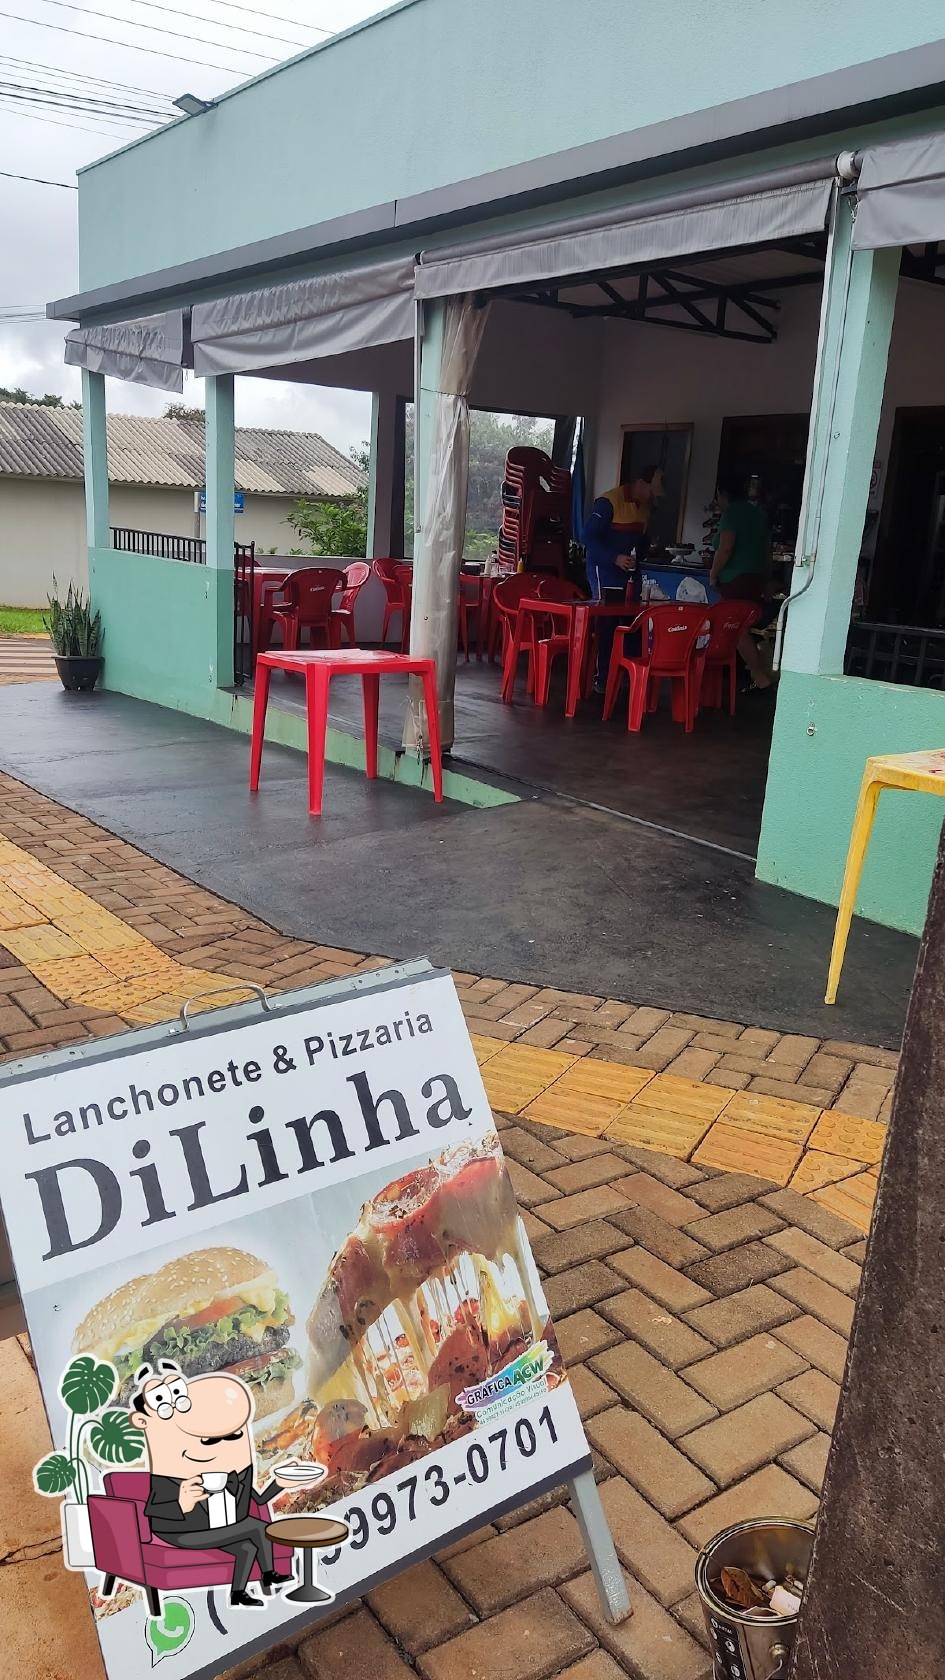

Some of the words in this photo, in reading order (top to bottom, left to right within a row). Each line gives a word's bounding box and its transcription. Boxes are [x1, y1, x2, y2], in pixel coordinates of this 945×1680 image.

[22, 1058, 263, 1145] Lanchonete
[272, 1044, 298, 1075] &
[303, 1010, 434, 1066] Pizzaria
[24, 1070, 473, 1261] DiLinha
